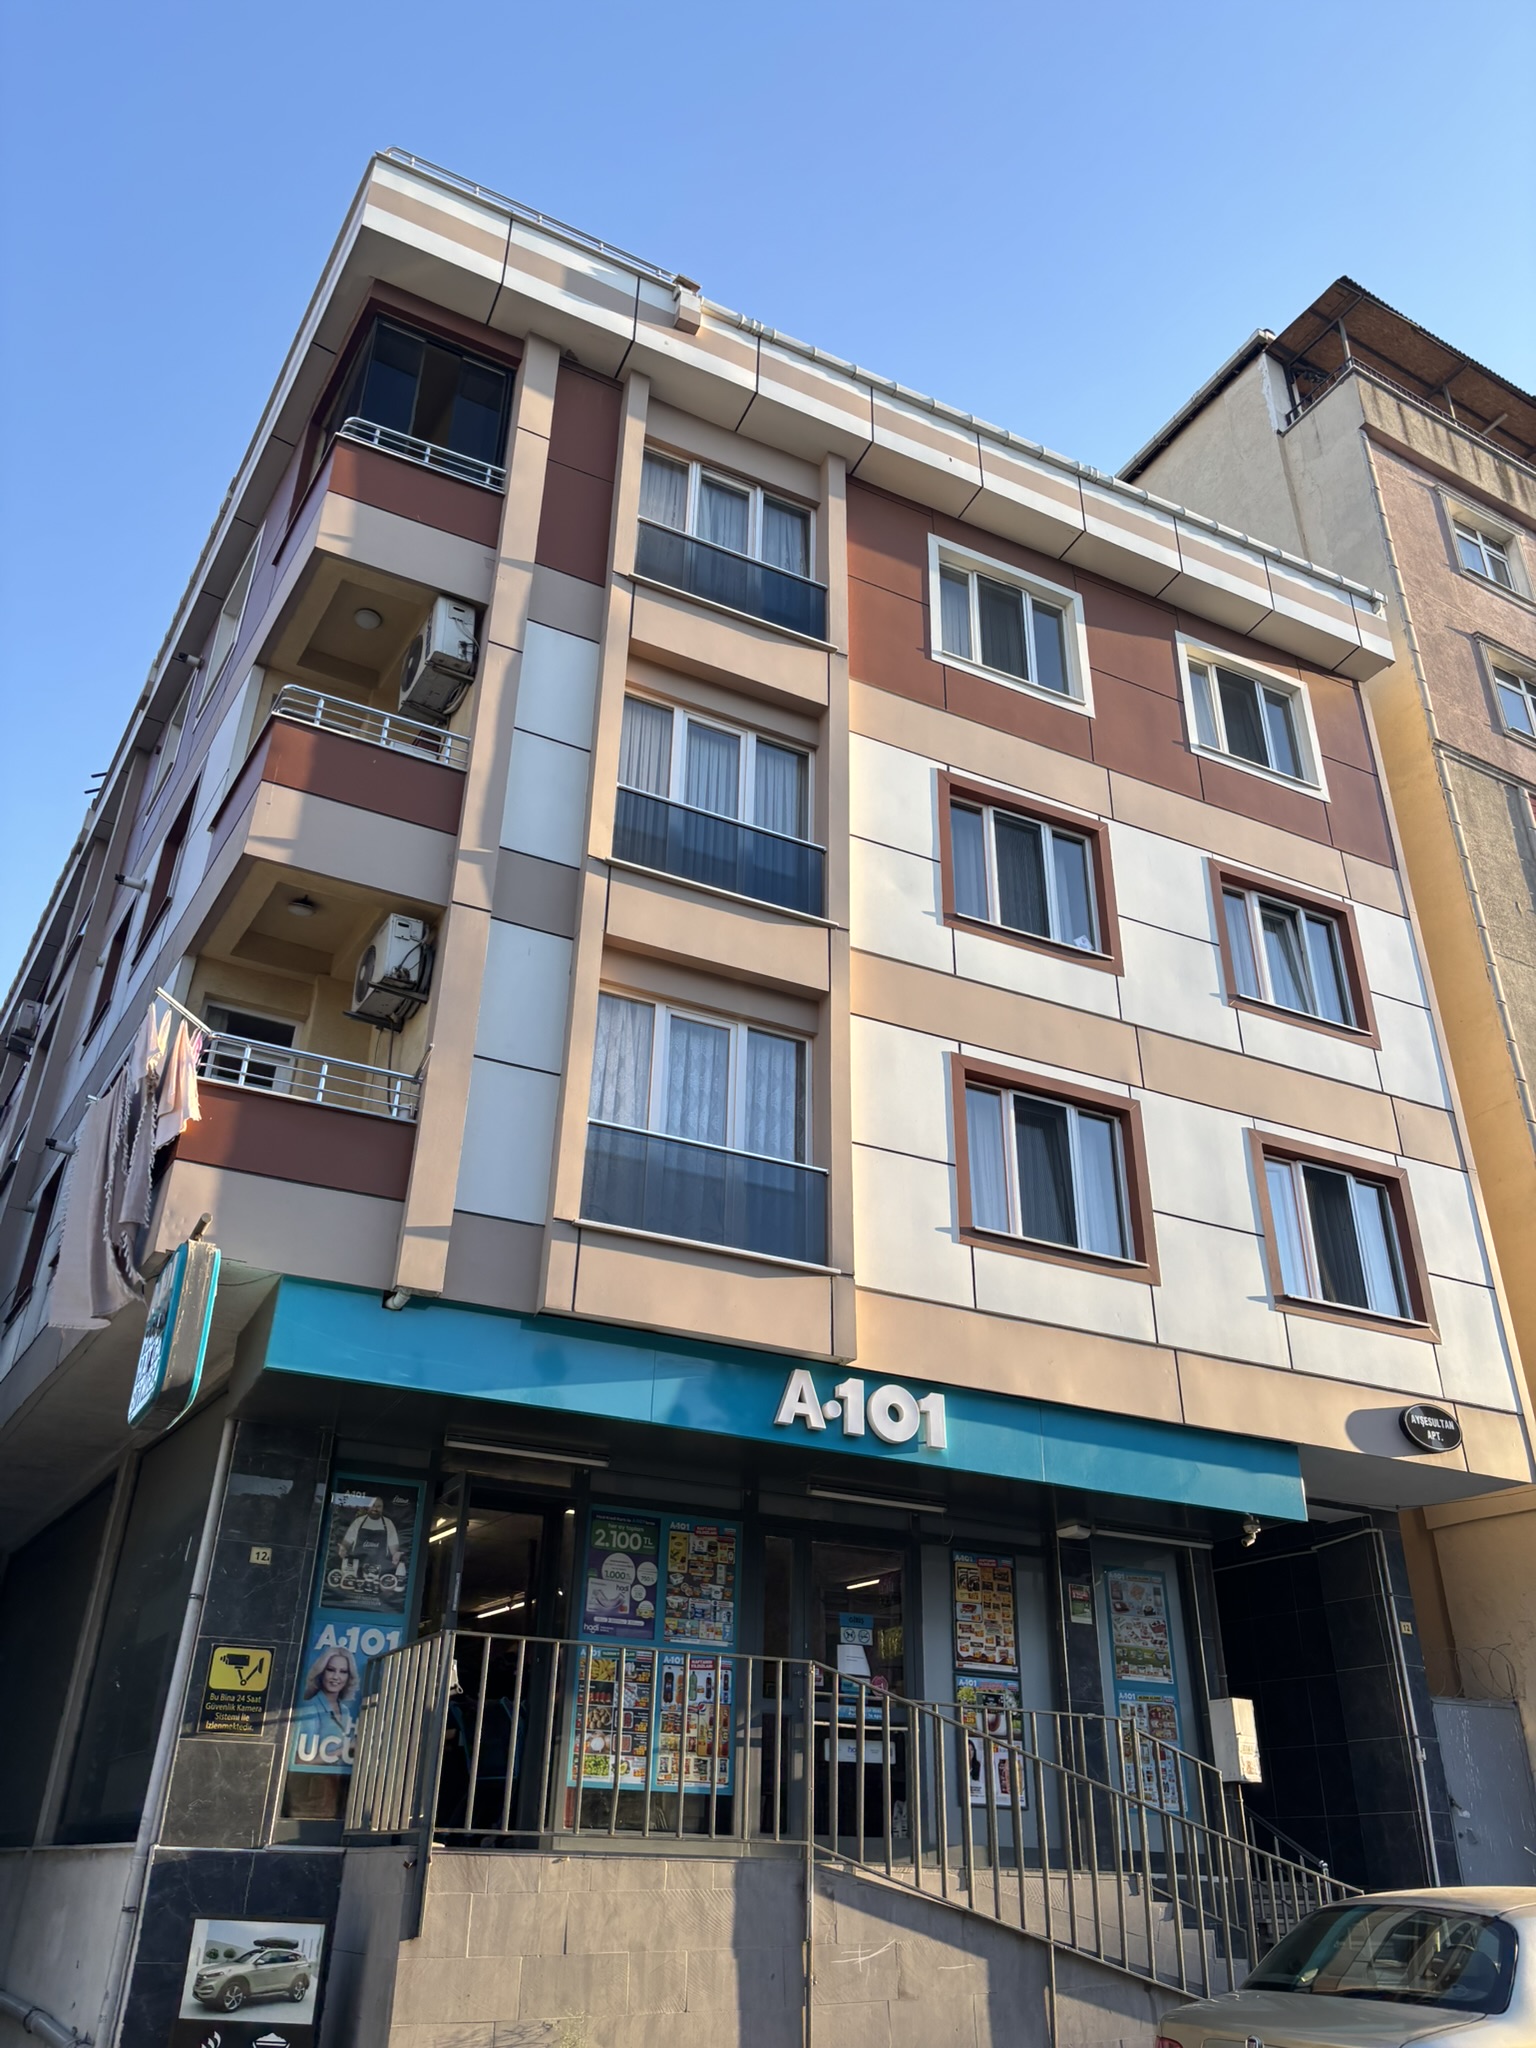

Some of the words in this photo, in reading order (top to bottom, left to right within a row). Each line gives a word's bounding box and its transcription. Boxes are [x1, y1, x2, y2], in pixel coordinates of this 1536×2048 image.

[1410, 1414, 1455, 1430] AYŞESULTAN
[1427, 1429, 1445, 1442] APT.
[594, 1528, 642, 1551] 2.100
[643, 1536, 653, 1545] TL
[209, 1692, 220, 1701] Bu
[219, 1693, 236, 1702] Bina
[236, 1694, 246, 1702] 24
[246, 1694, 262, 1703] Saat
[205, 1701, 236, 1711] Güvenlik
[236, 1703, 263, 1713] Kamera
[214, 1711, 241, 1721] Sistemi
